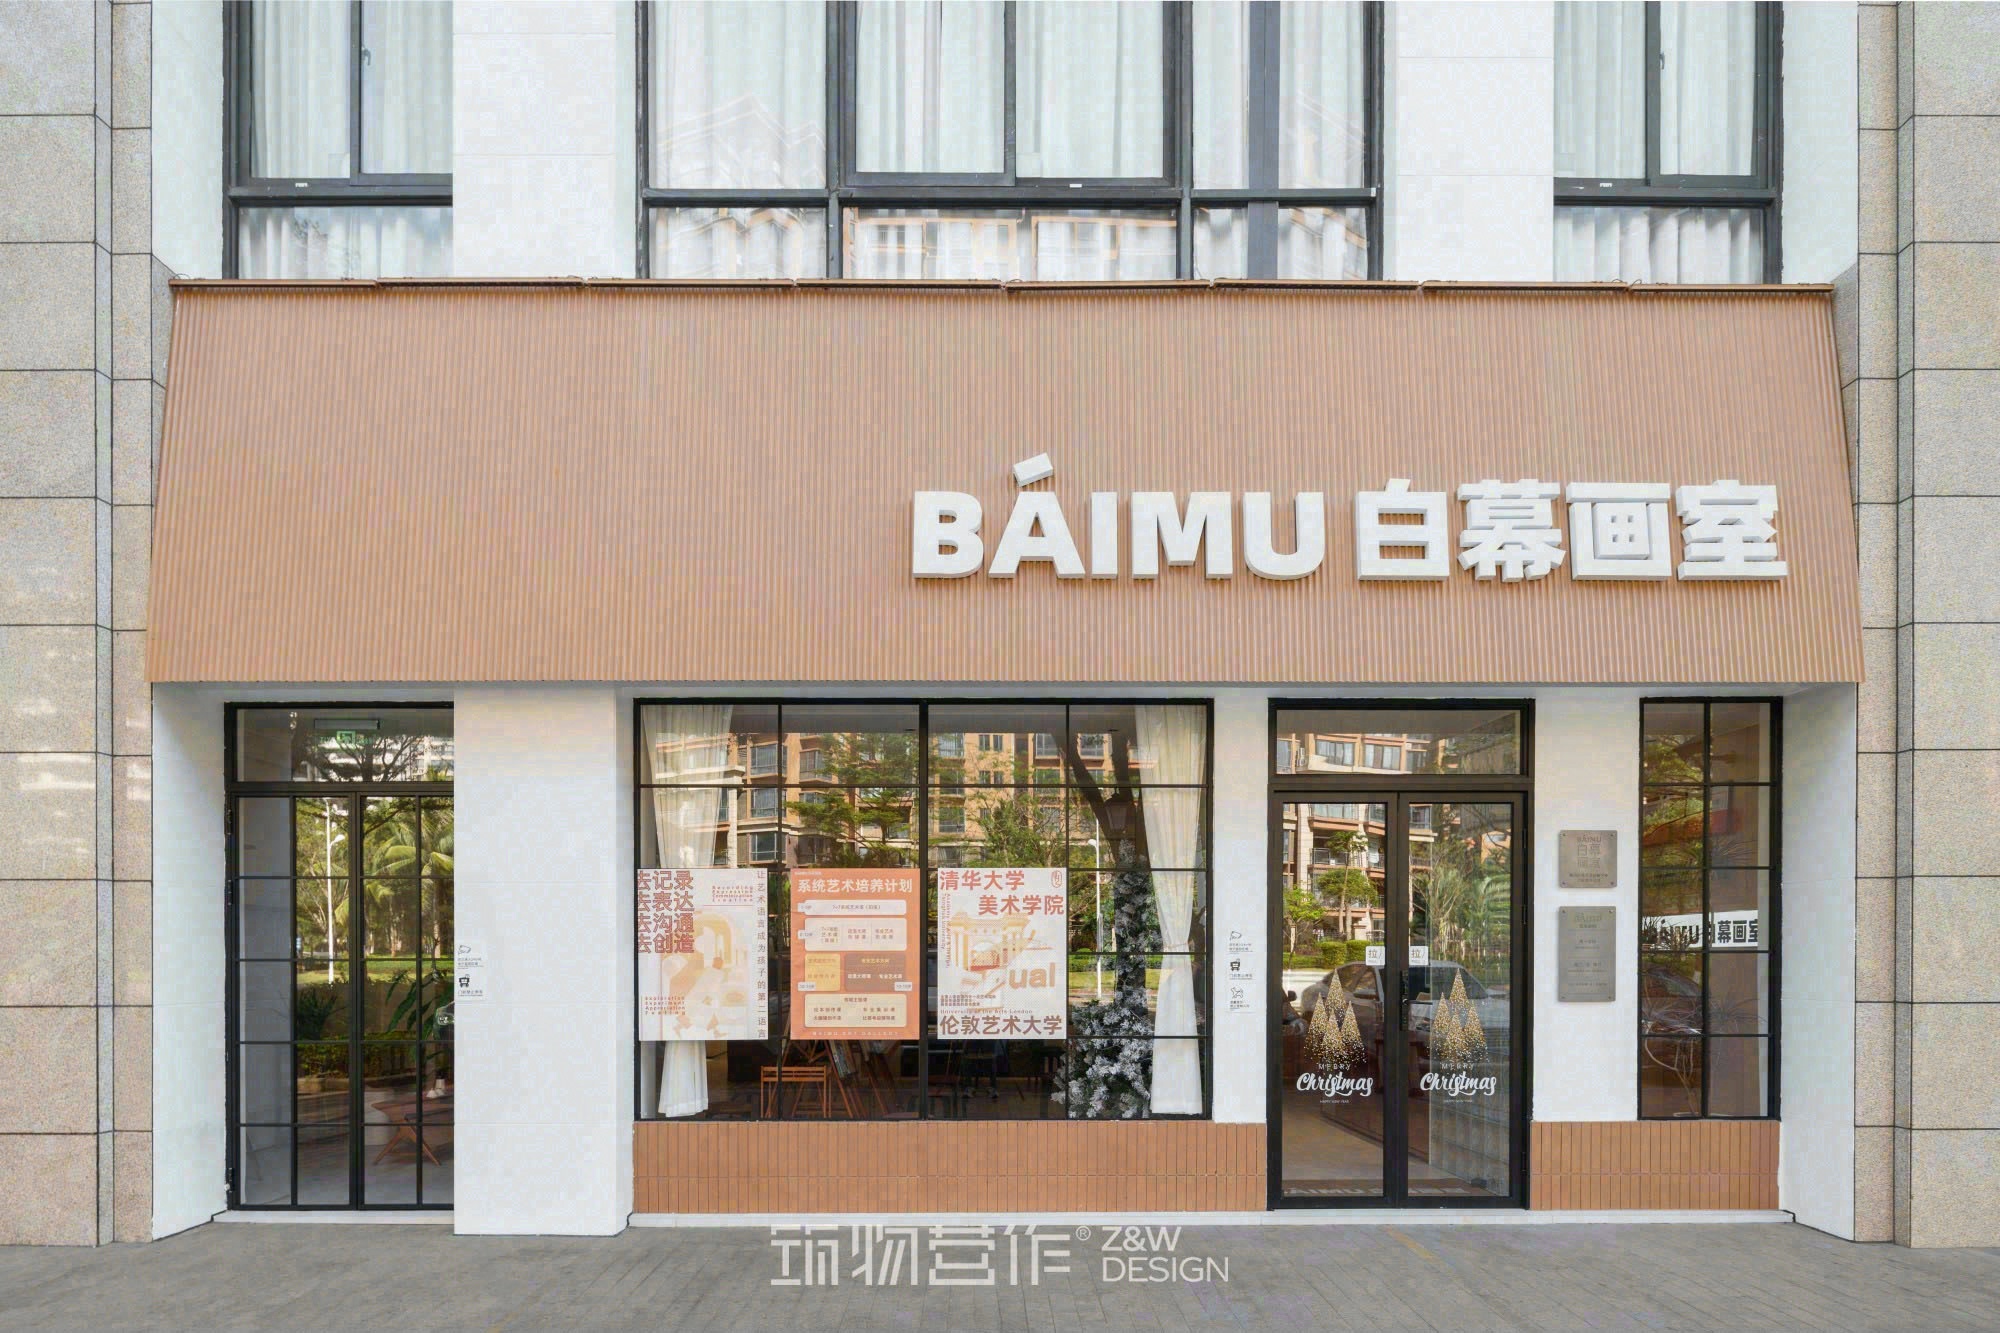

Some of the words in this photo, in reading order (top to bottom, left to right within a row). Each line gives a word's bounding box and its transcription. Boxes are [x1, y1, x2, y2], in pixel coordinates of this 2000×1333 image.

[913, 453, 1326, 580] BÁIMU
[1356, 479, 1788, 582] 白幕画室
[637, 870, 694, 891] 去记录
[798, 878, 913, 893] 系统艺术培养计划
[940, 870, 1025, 891] 清华大学
[637, 891, 695, 912] 去表达
[978, 894, 1065, 916] 美术学院
[637, 912, 695, 933] 去沟通
[637, 933, 695, 954] 去创造
[1009, 962, 1056, 989] ual
[939, 1015, 1063, 1036] 伦敦艺术大学
[1318, 1063, 1351, 1071] MERRY
[1296, 1071, 1373, 1097] Christmas
[1420, 1071, 1497, 1096] Christmas
